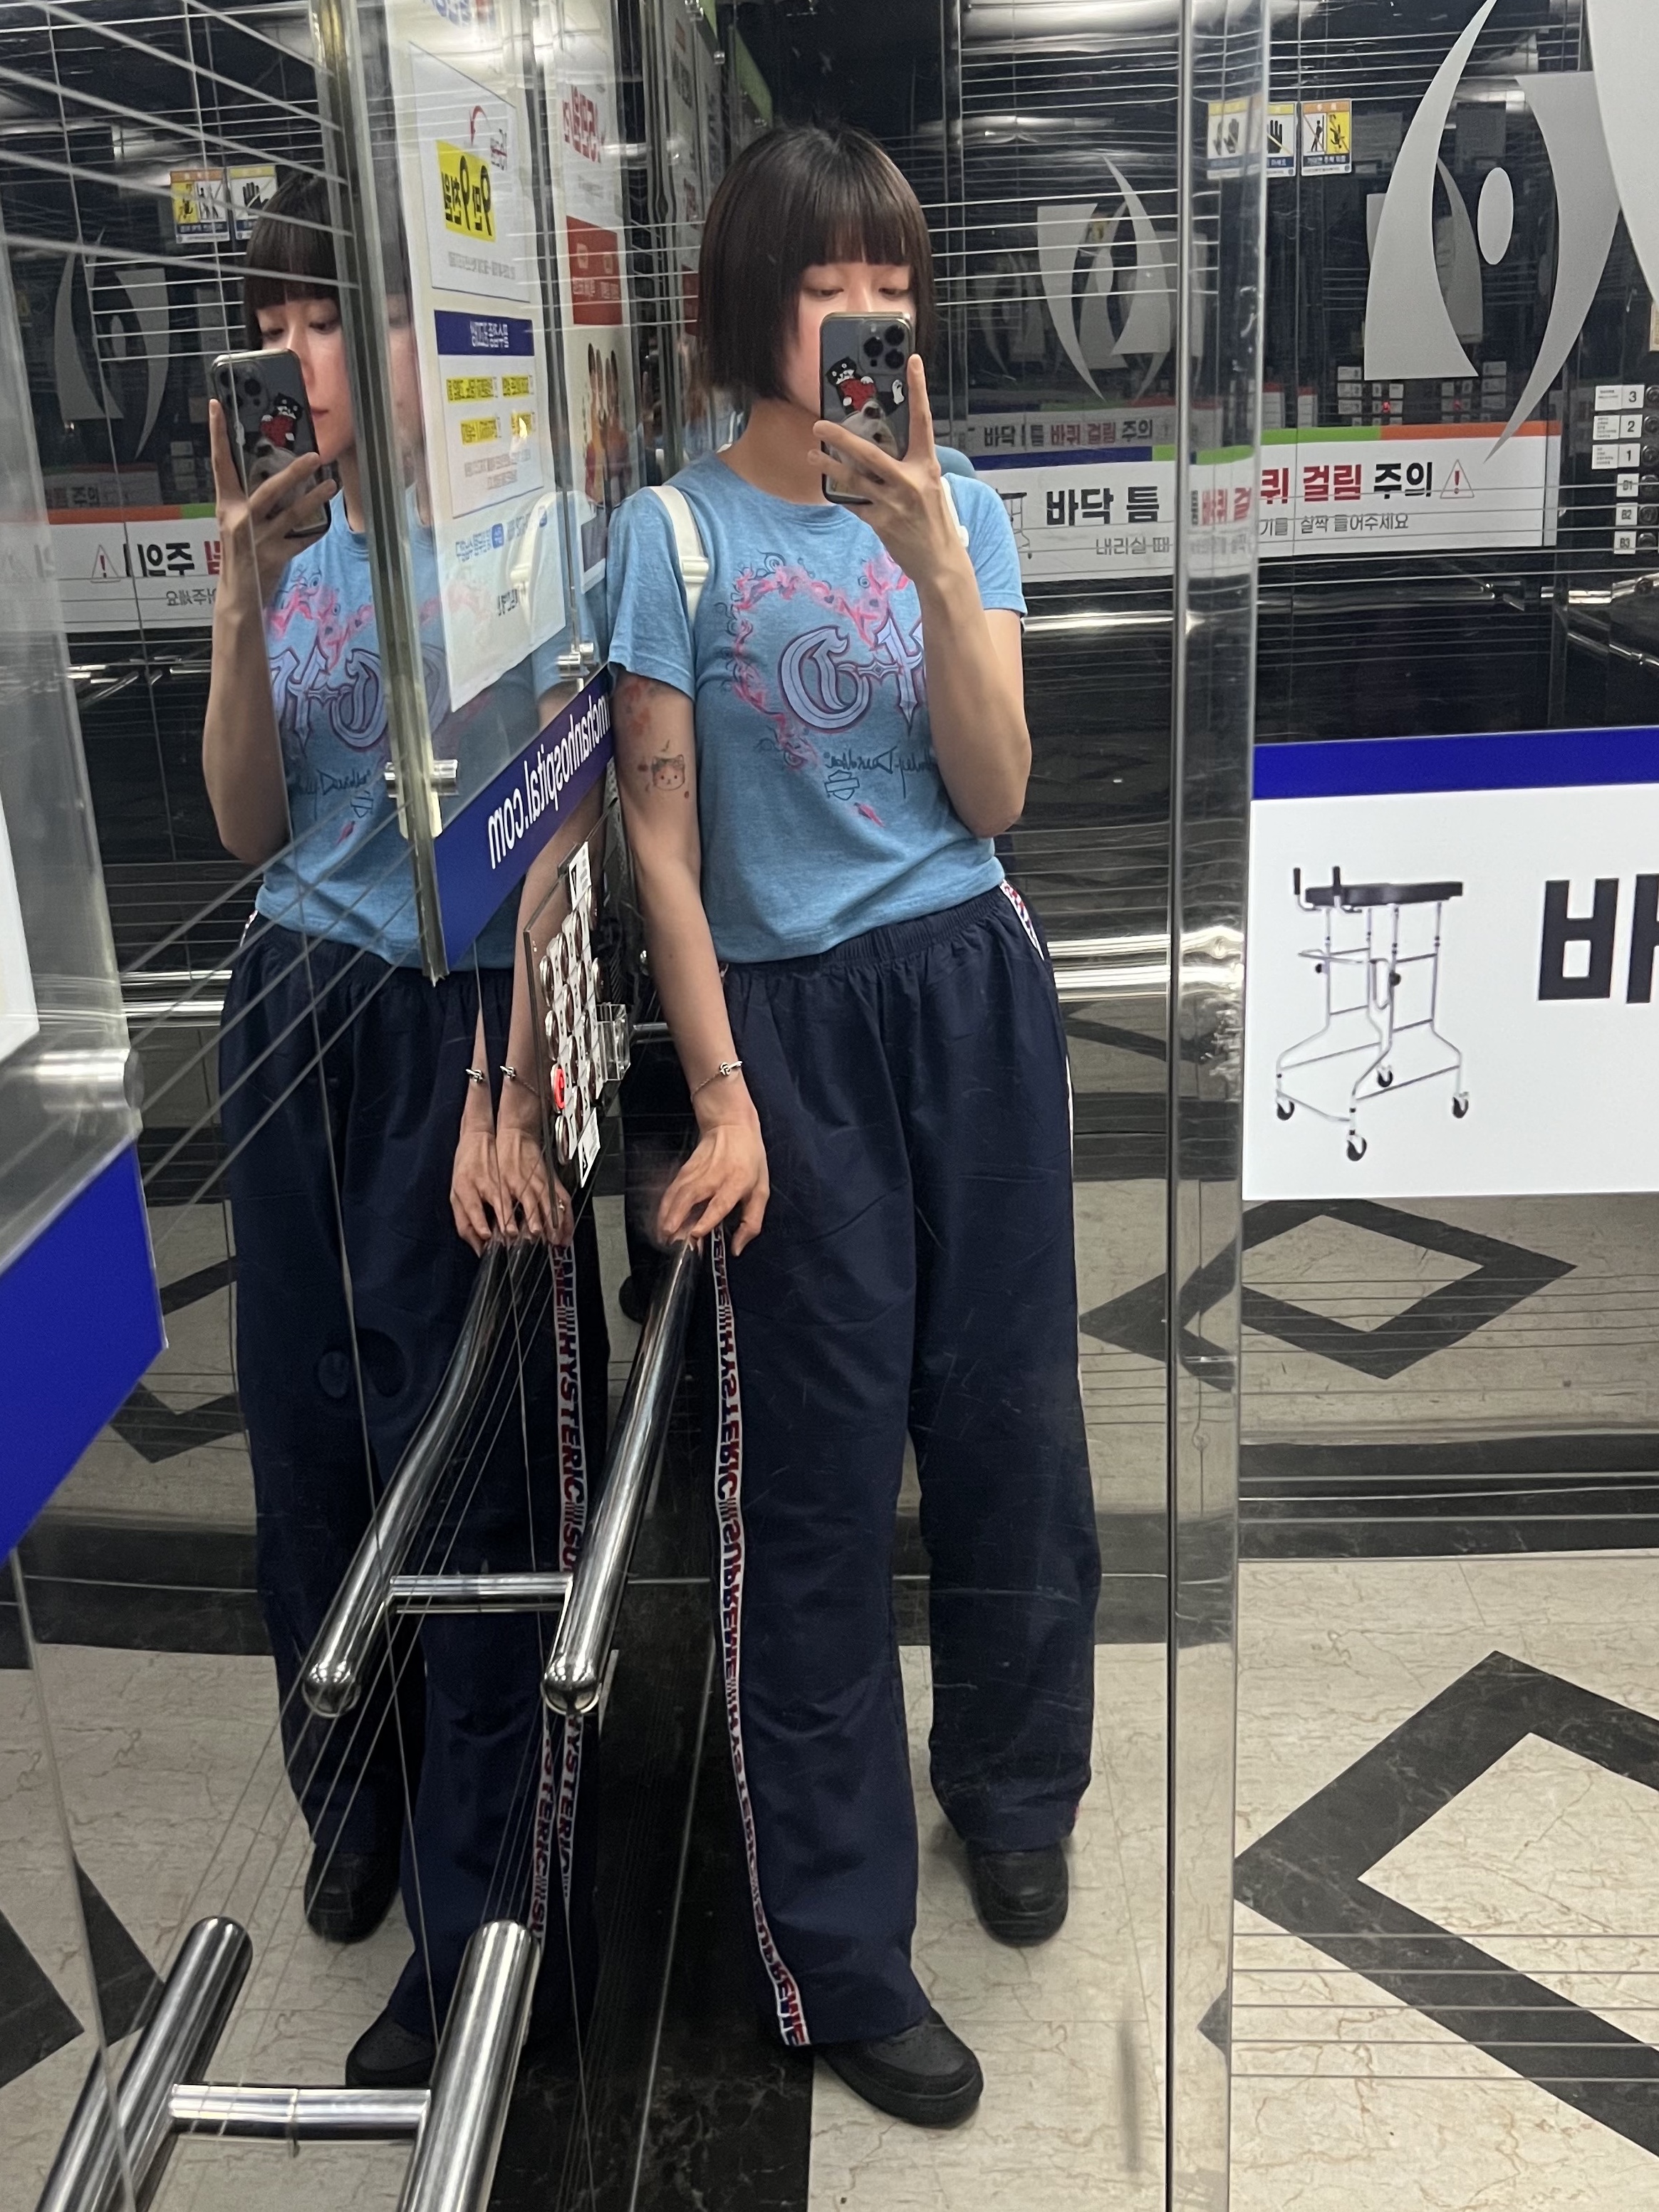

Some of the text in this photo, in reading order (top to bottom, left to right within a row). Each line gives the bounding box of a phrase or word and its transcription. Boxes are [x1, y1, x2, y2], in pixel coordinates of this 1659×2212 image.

[1628, 391, 1637, 403] 3
[984, 426, 1015, 447] 바닥
[1051, 424, 1081, 447] 바퀴
[1122, 419, 1153, 443] 주의
[1628, 421, 1635, 432] 2
[1626, 450, 1631, 461] 1
[1260, 461, 1433, 504] 퀴 걸림 주의
[1046, 489, 1114, 526] 바닥
[1126, 486, 1160, 523] 틈
[1621, 510, 1631, 520] B2
[1301, 514, 1329, 535] 살짝
[1333, 513, 1409, 533] 들어주세요
[1096, 536, 1147, 556] 내리실
[1620, 538, 1630, 548] B3
[557, 1332, 584, 1504] HYSTERIC
